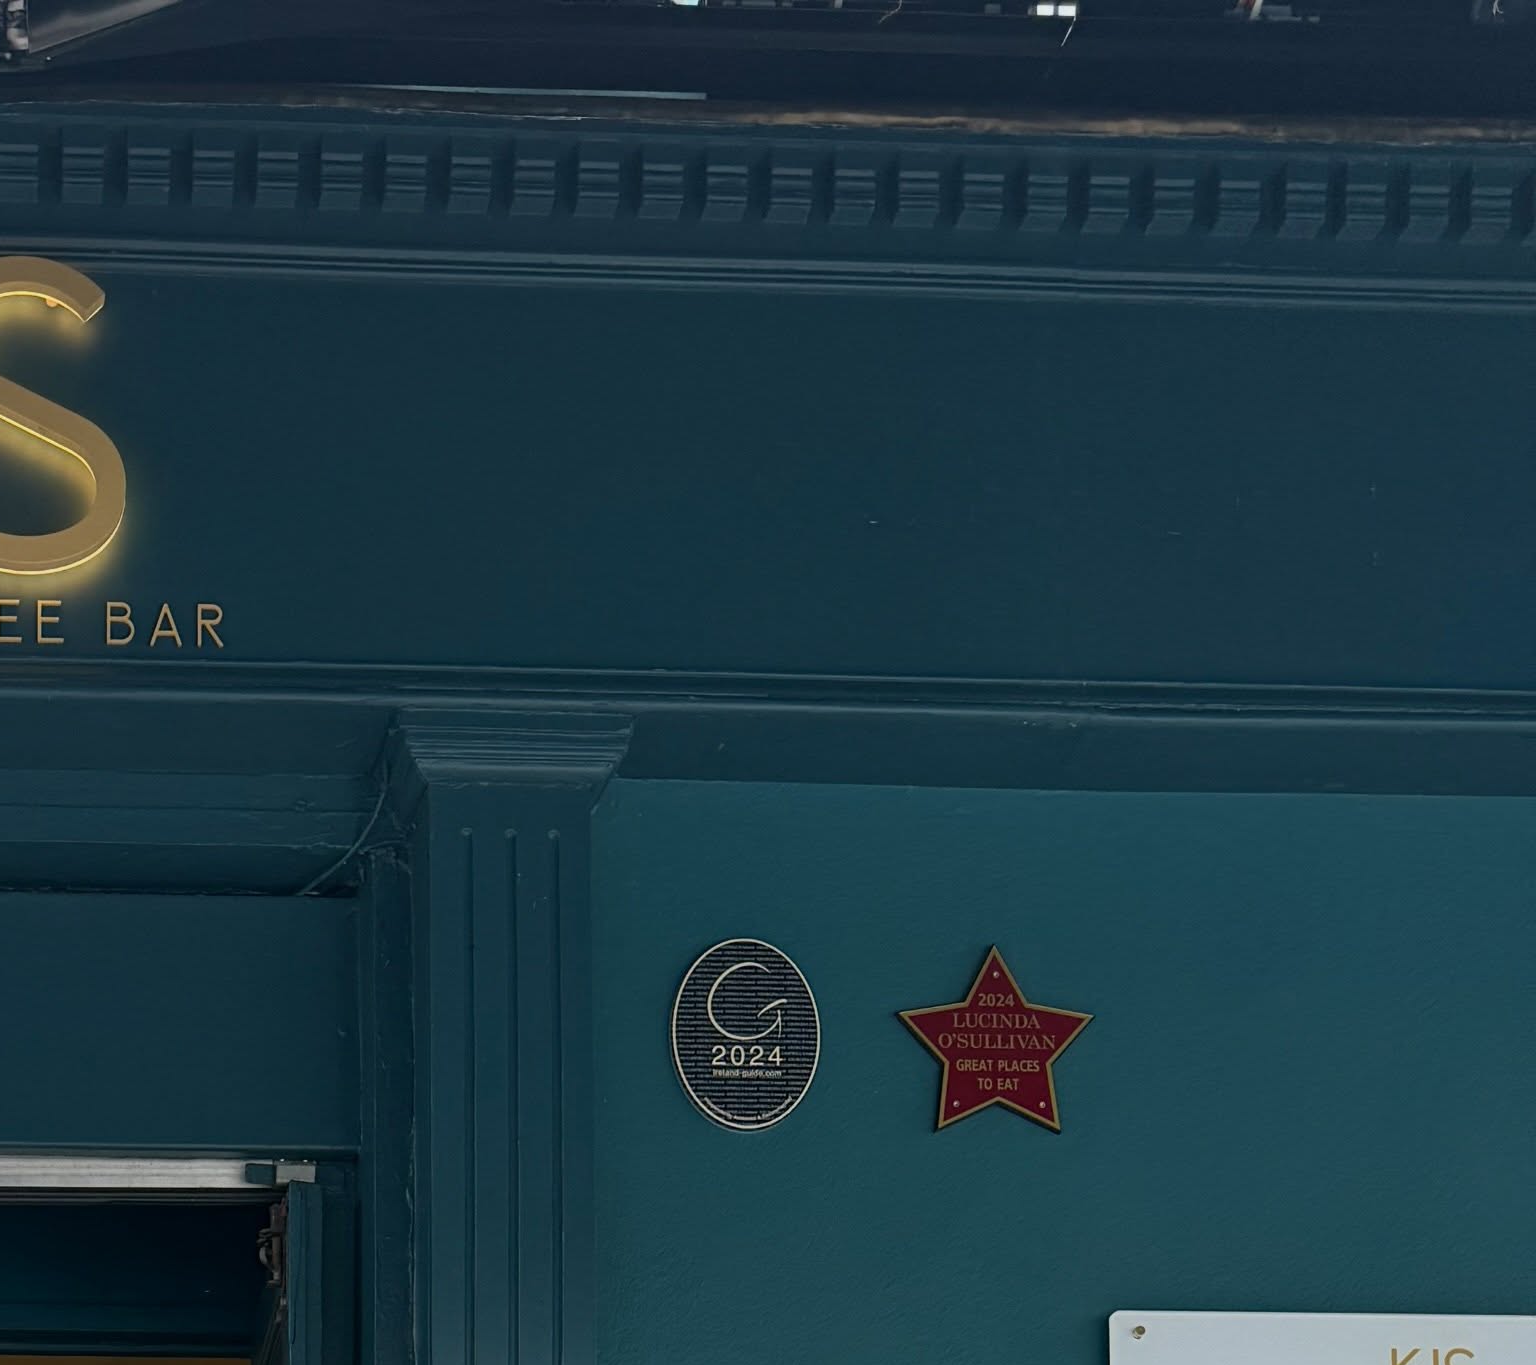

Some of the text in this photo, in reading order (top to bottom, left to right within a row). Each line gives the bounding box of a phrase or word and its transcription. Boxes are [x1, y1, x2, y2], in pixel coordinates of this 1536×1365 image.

[105, 602, 225, 648] BAR
[977, 993, 1015, 1007] 2024
[953, 1013, 1041, 1029] LUCINDA
[711, 1045, 783, 1067] 2024
[956, 1058, 1040, 1072] GREAT PLACES
[977, 1078, 1020, 1091] TO EAT
